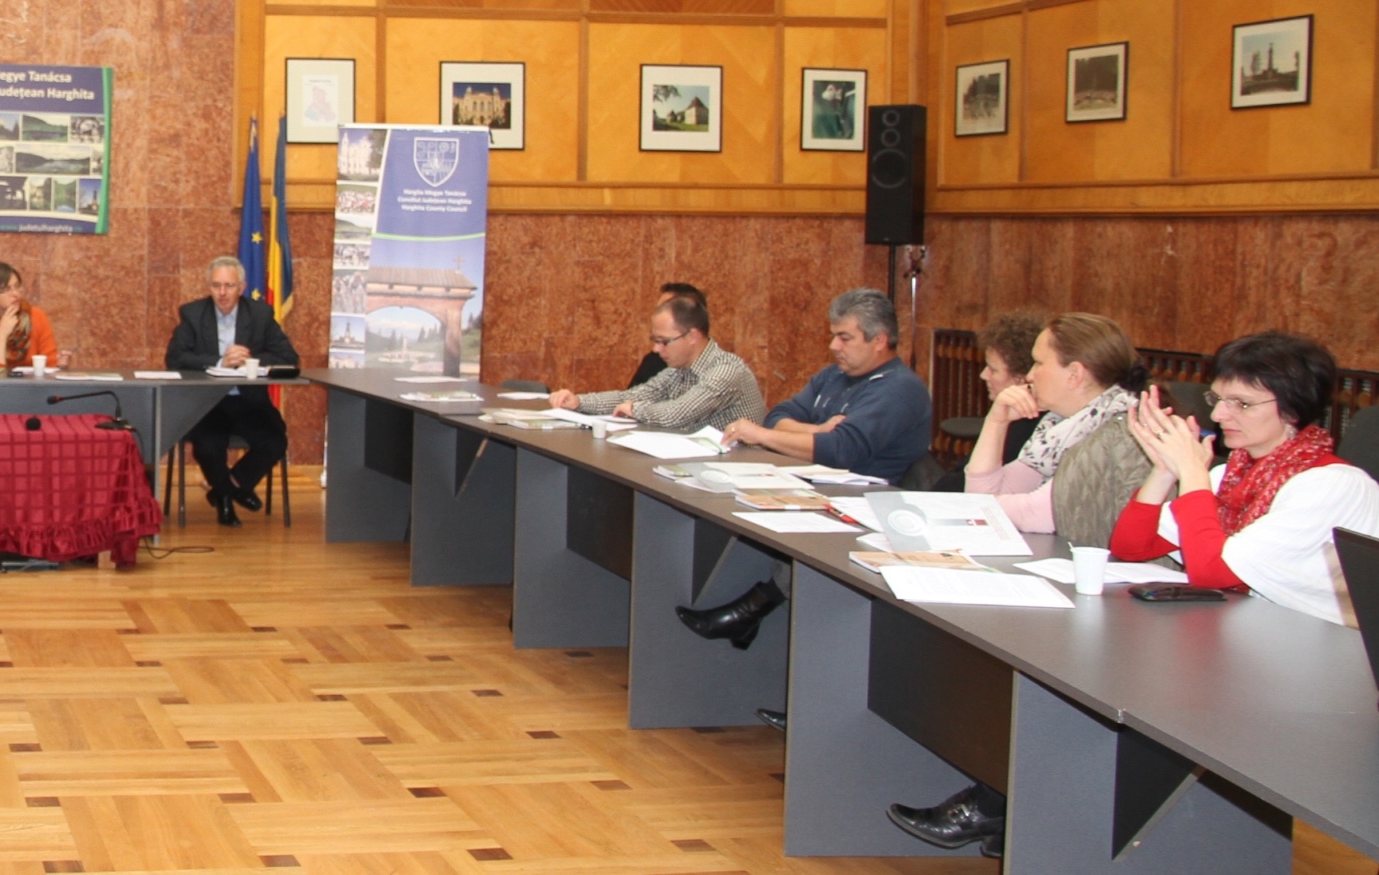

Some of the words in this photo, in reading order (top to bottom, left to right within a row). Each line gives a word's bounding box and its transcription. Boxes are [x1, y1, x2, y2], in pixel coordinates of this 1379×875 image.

[27, 70, 73, 83] Tanácsa
[46, 87, 95, 102] Harghita
[424, 189, 443, 197] Megye
